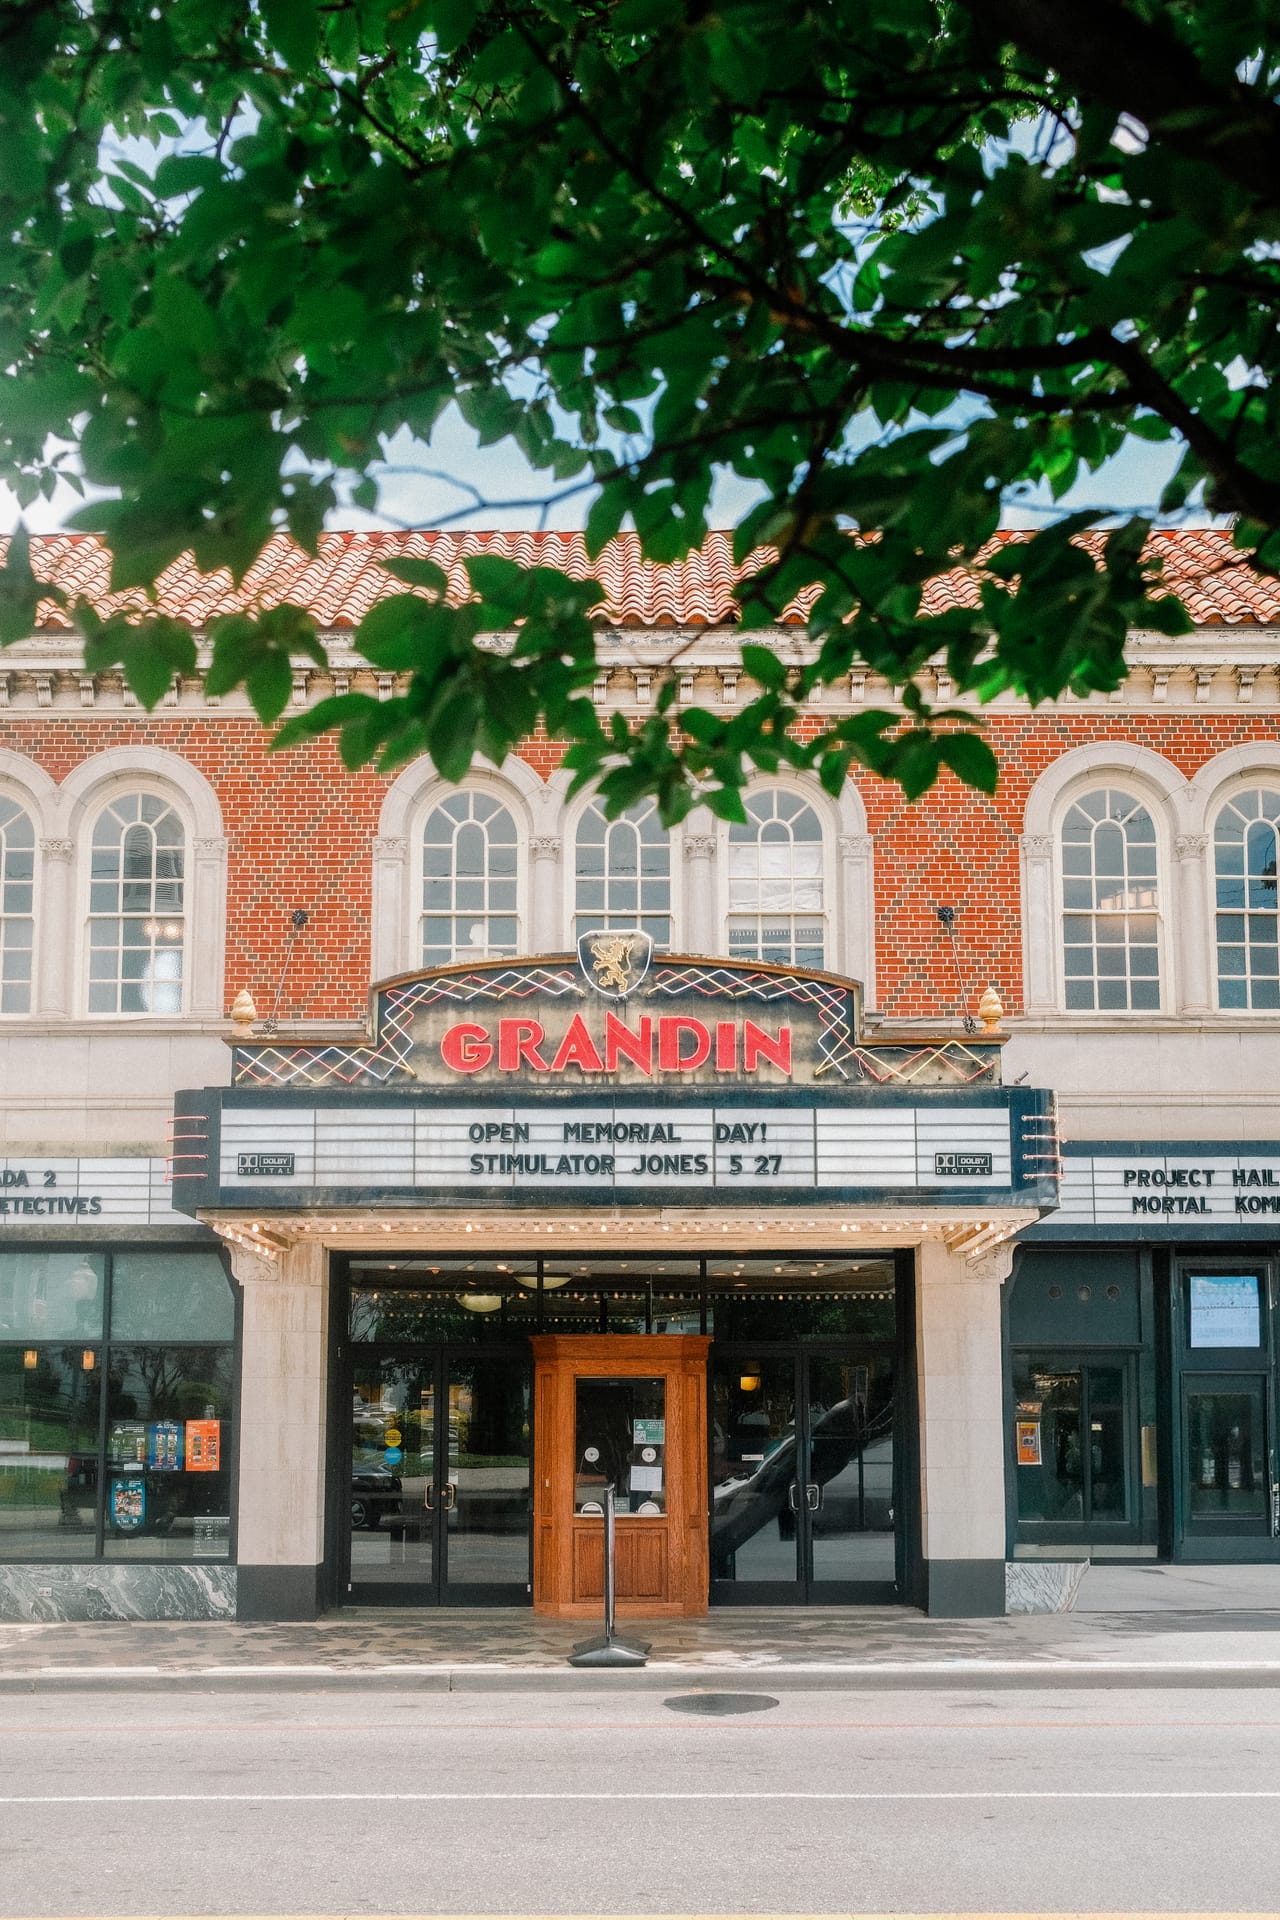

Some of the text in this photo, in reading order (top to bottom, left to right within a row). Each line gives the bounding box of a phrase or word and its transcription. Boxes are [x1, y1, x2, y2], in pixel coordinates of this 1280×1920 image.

[440, 1010, 793, 1076] GRANDIN
[468, 1122, 768, 1143] OPEN MEMORIAL DAY!
[469, 1153, 783, 1176] STIMULATOR JONES 5 27
[0, 1169, 57, 1188] DA 2
[1123, 1169, 1280, 1187] PROJECT HAIL
[0, 1196, 103, 1215] ETECTIVES
[1132, 1196, 1280, 1214] MORTAL KOM
